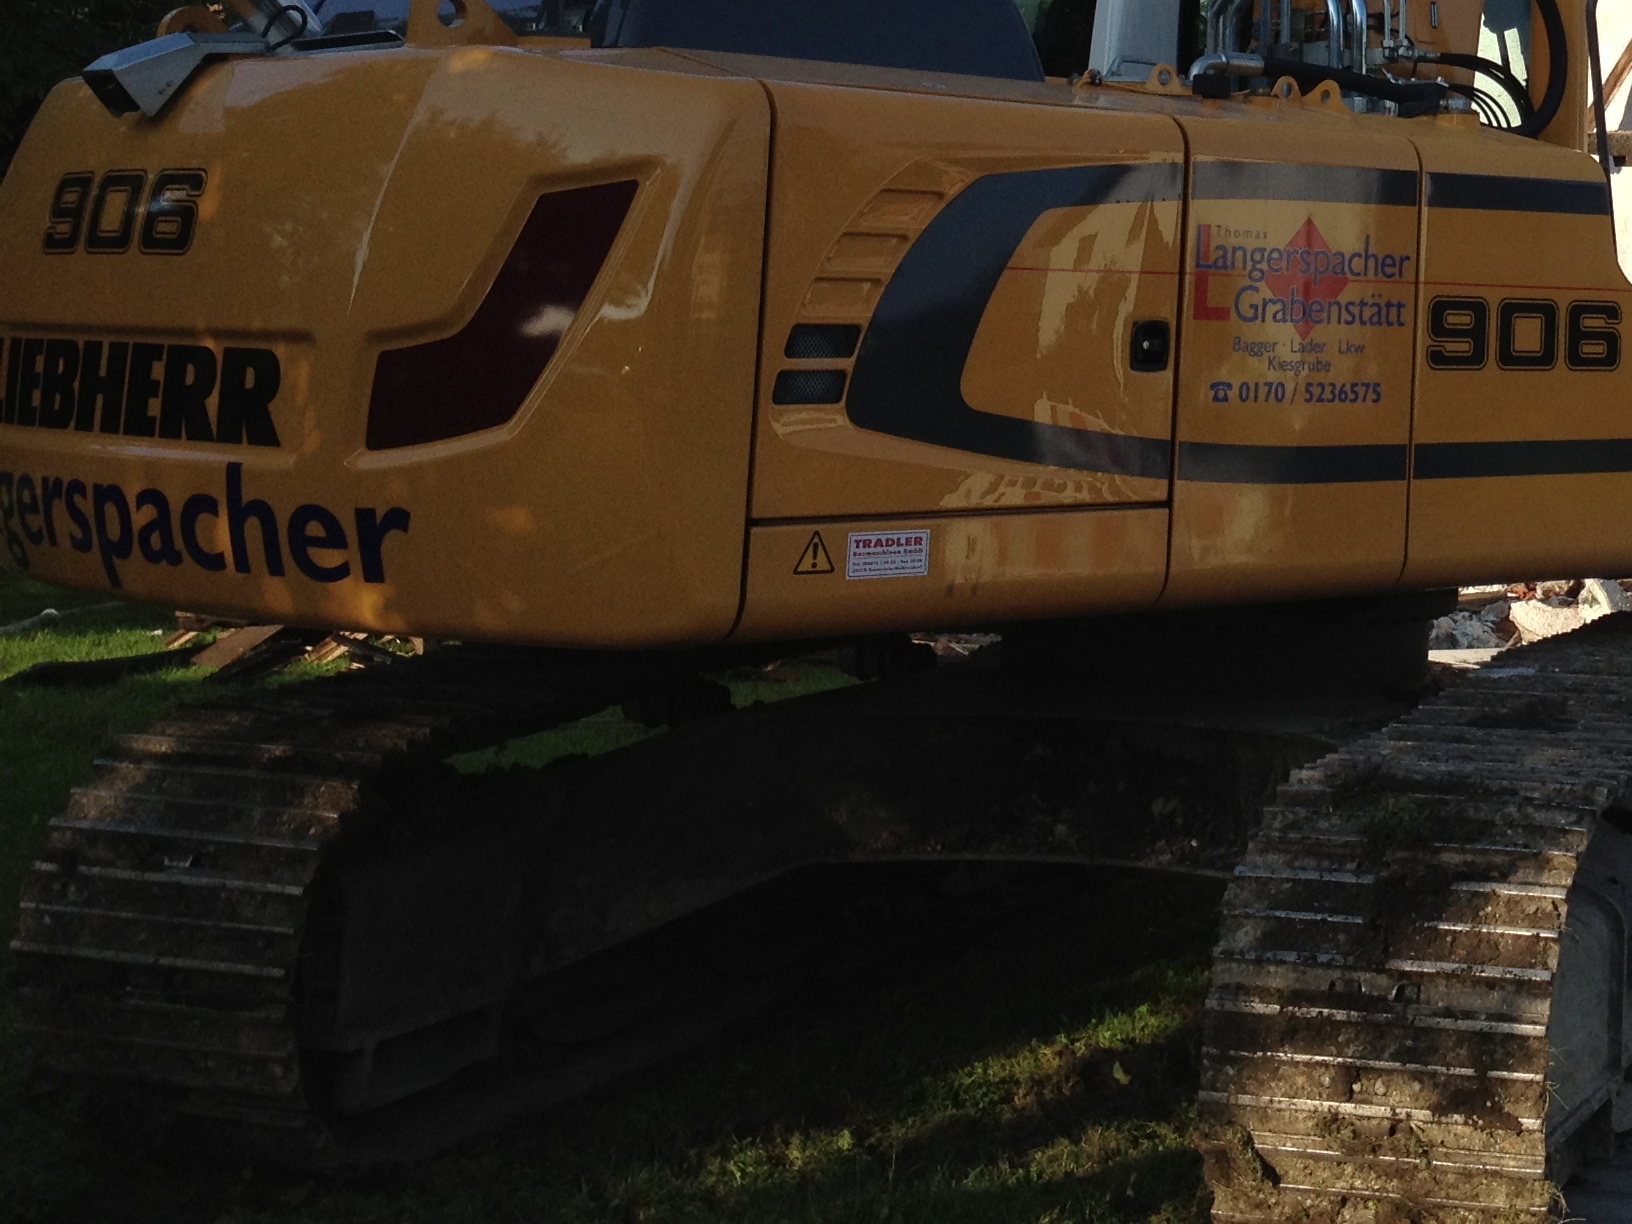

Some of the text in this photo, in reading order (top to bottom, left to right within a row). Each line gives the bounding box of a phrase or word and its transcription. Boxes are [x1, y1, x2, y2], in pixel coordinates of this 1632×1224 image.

[43, 168, 207, 254] 906
[1214, 224, 1268, 240] Thomas
[1195, 224, 1411, 284] Langerspacher
[1233, 284, 1406, 327] Grabenstätt
[1232, 335, 1365, 356] Bagger Lader Lkw
[1426, 295, 1622, 372] 906
[1267, 356, 1332, 376] Kiesgrube
[0, 336, 281, 447] IEBHERR
[1237, 381, 1286, 403] 0170
[1303, 382, 1382, 404] 5236575
[854, 536, 923, 549] TRADLER
